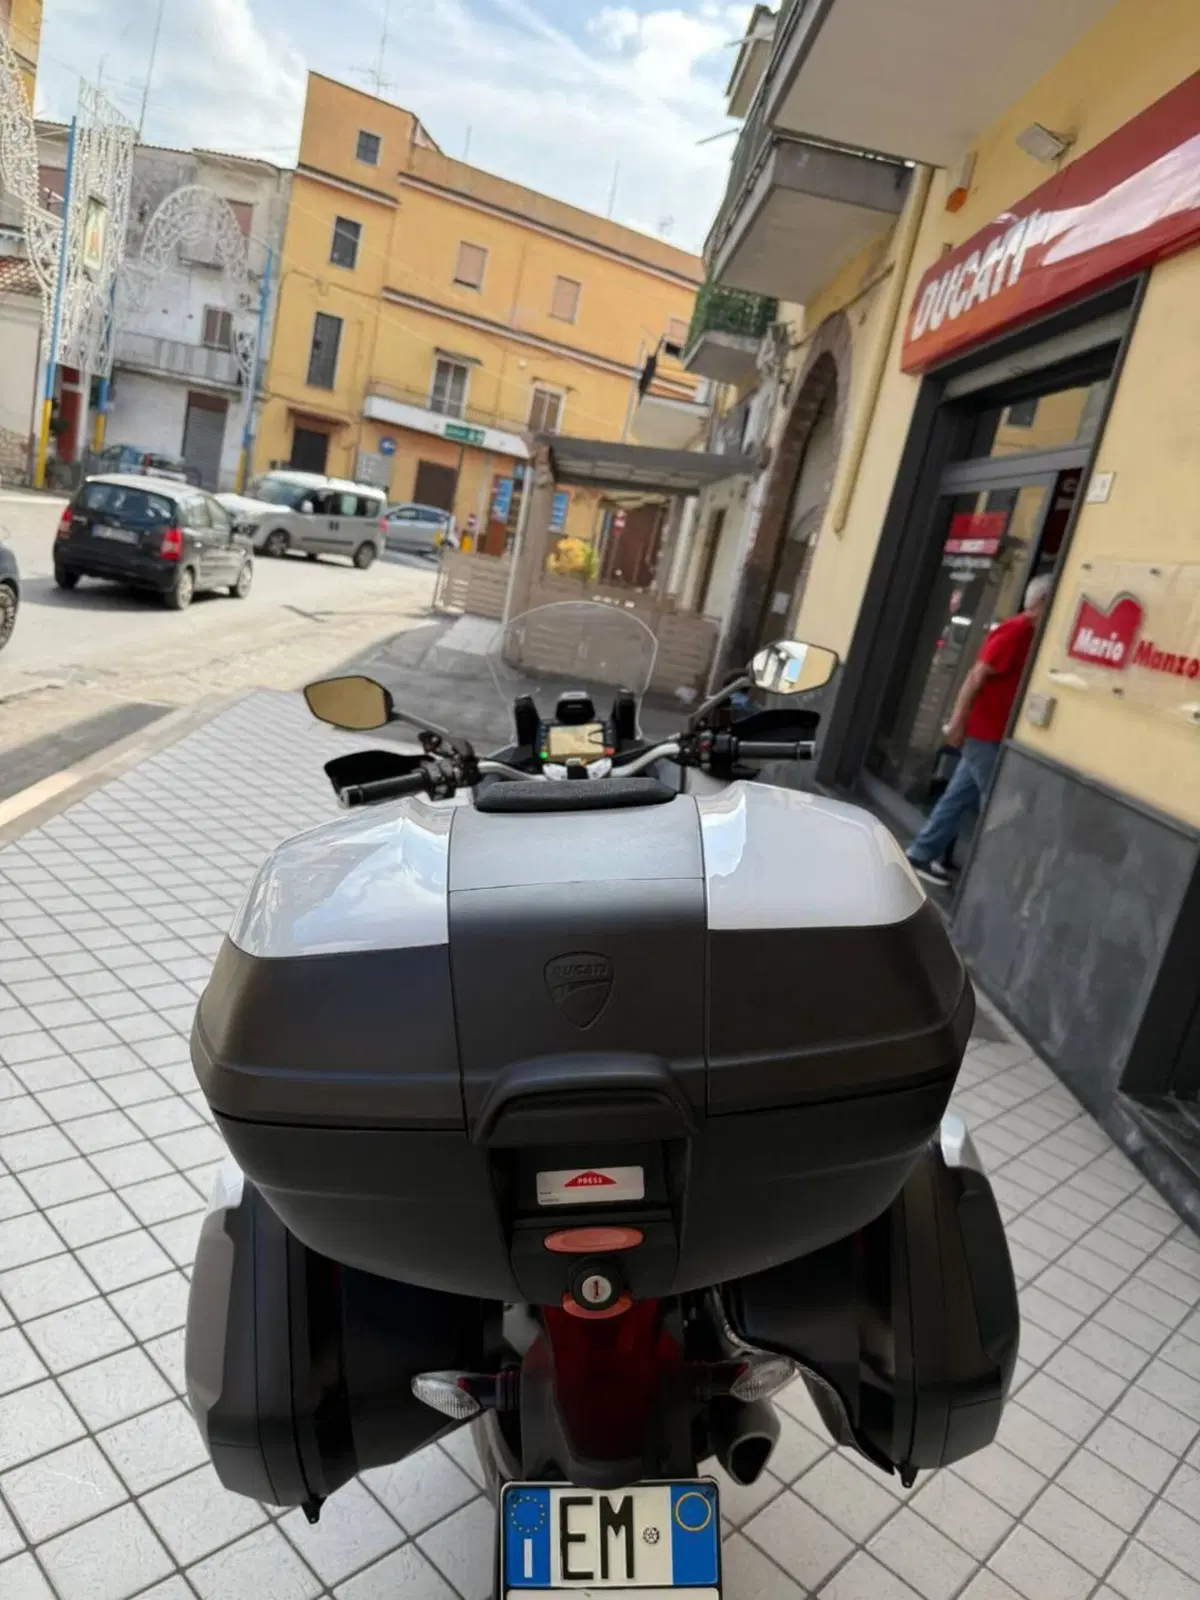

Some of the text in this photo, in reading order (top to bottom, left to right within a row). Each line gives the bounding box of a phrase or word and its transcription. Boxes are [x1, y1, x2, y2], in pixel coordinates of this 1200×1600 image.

[911, 209, 1041, 342] DUCATI
[1073, 627, 1200, 678] Mario Manzo
[577, 1177, 603, 1185] PRESS
[523, 1538, 533, 1579] I
[560, 1495, 635, 1581] EM
